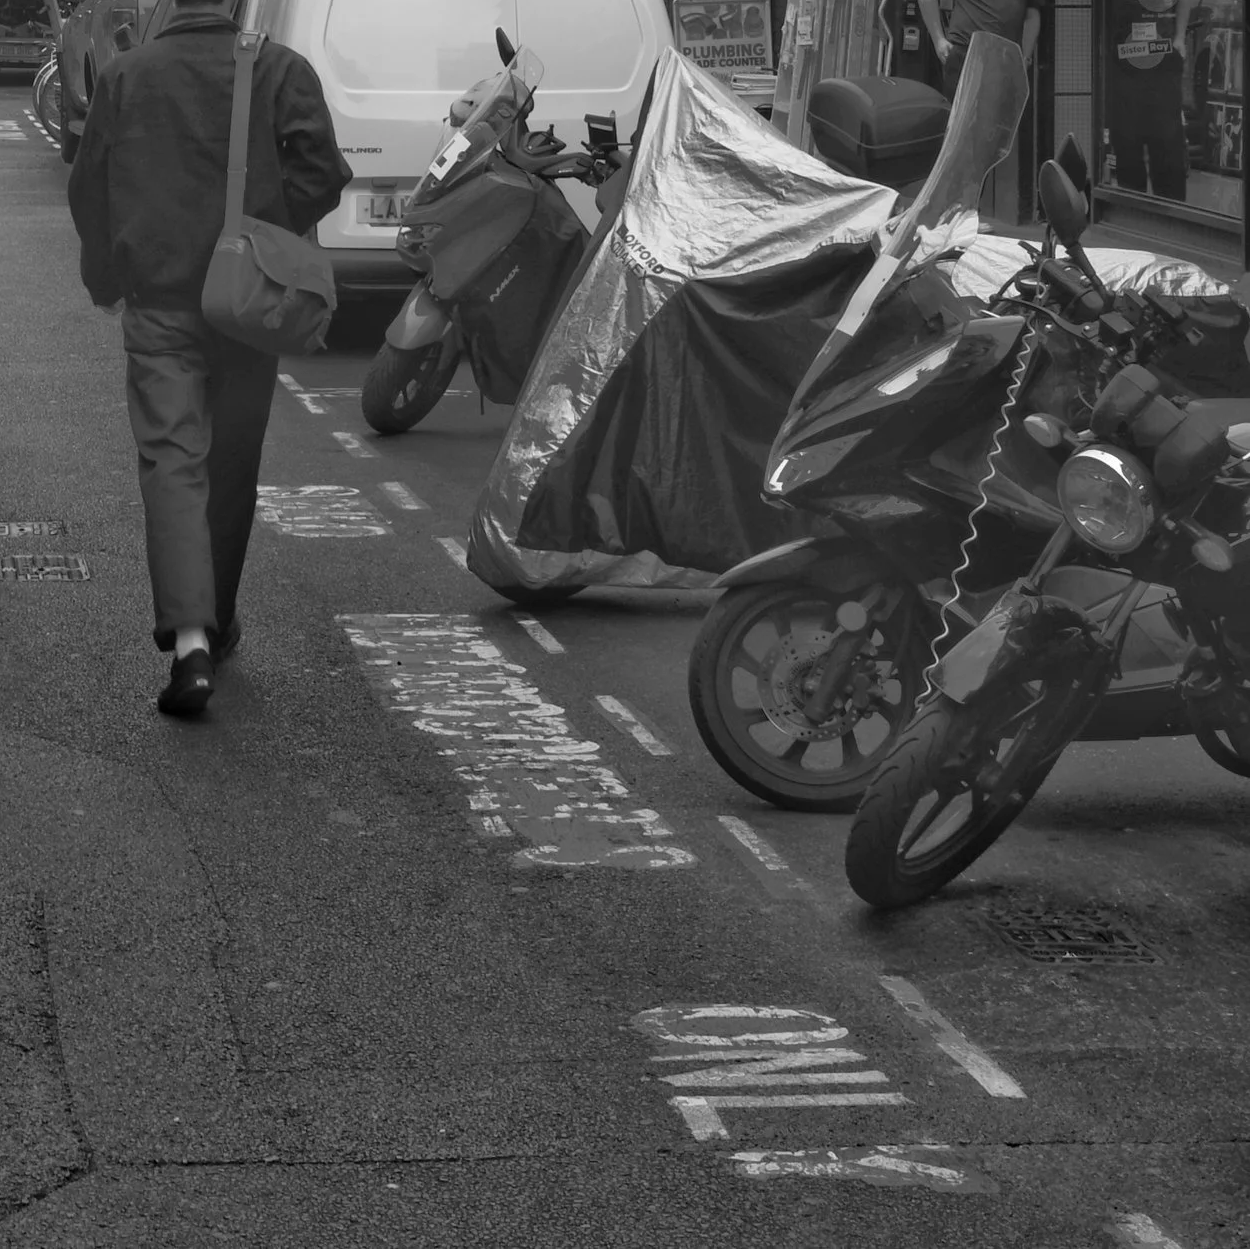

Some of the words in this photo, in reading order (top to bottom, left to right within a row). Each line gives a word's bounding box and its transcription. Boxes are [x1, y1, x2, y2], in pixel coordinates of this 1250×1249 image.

[682, 43, 766, 59] PLUMBING
[1119, 45, 1147, 56] Sister
[1149, 41, 1170, 54] Ray
[694, 59, 717, 68] ADE
[719, 56, 766, 67] COUNTER
[623, 234, 665, 274] OXFORD
